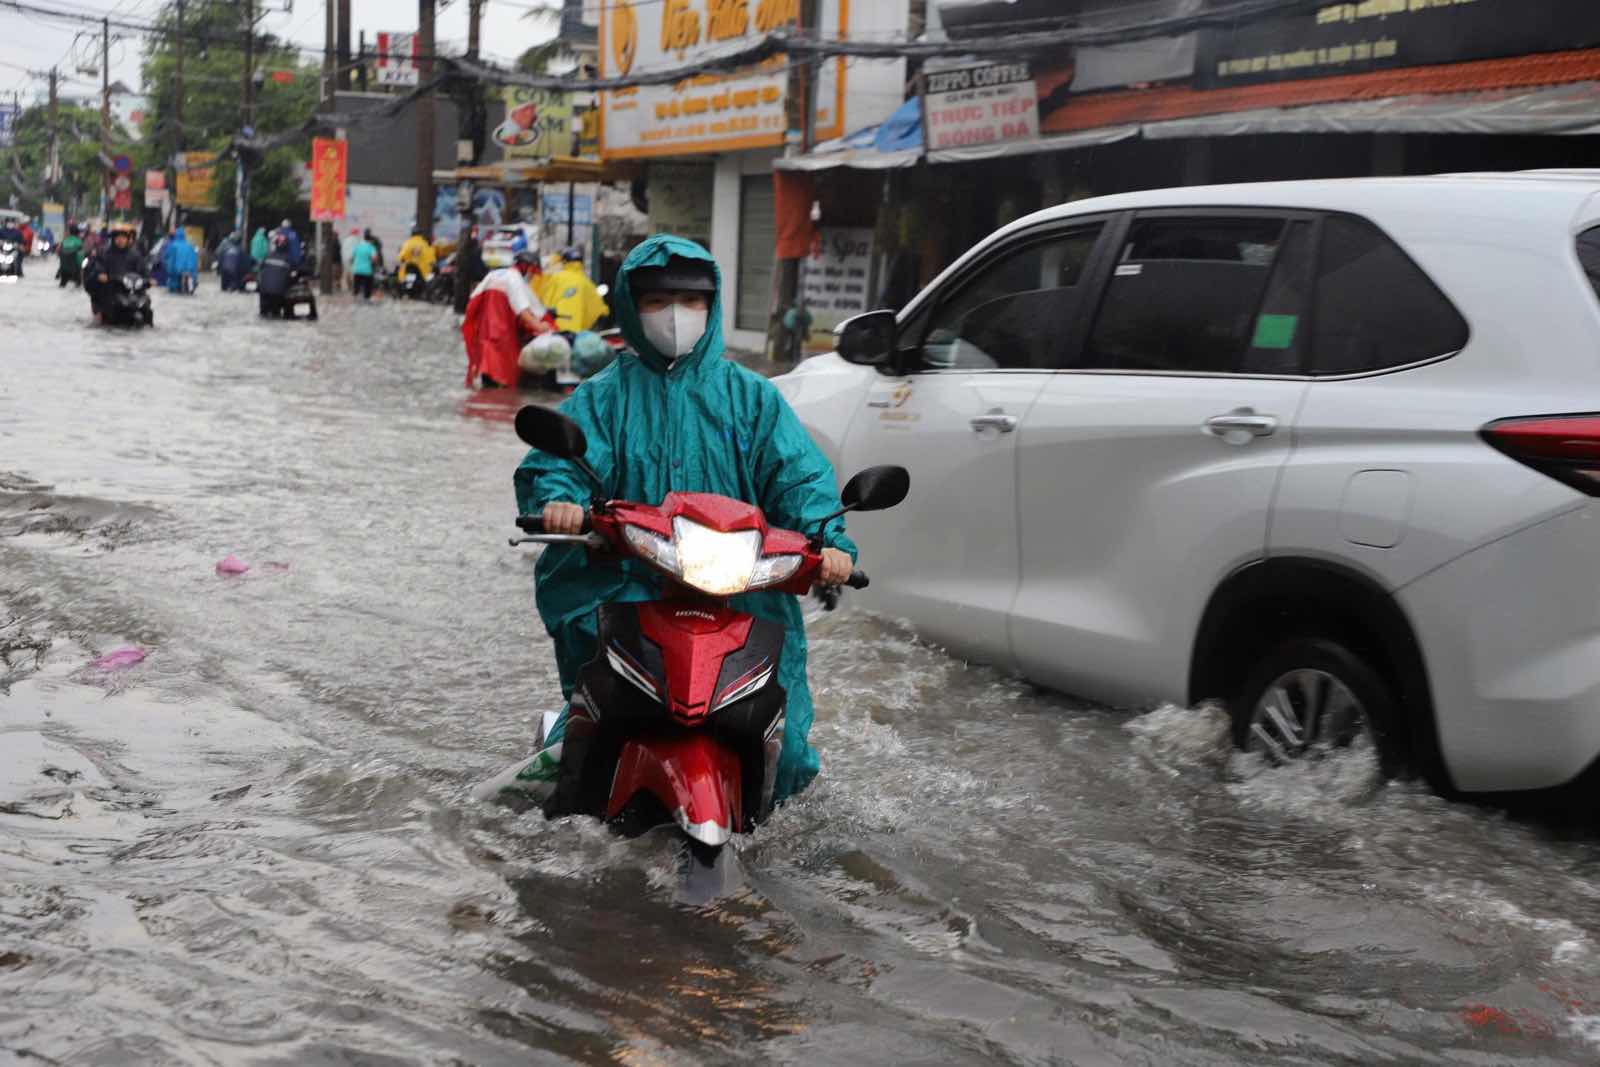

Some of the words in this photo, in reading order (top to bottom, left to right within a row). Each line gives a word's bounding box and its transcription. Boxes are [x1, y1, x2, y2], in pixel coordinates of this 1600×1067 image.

[928, 73, 970, 92] ZIPPO
[972, 64, 1028, 86] COFFEE
[991, 97, 1033, 117] TIẾP
[831, 234, 869, 262] Spa
[675, 610, 716, 621] HONDA
